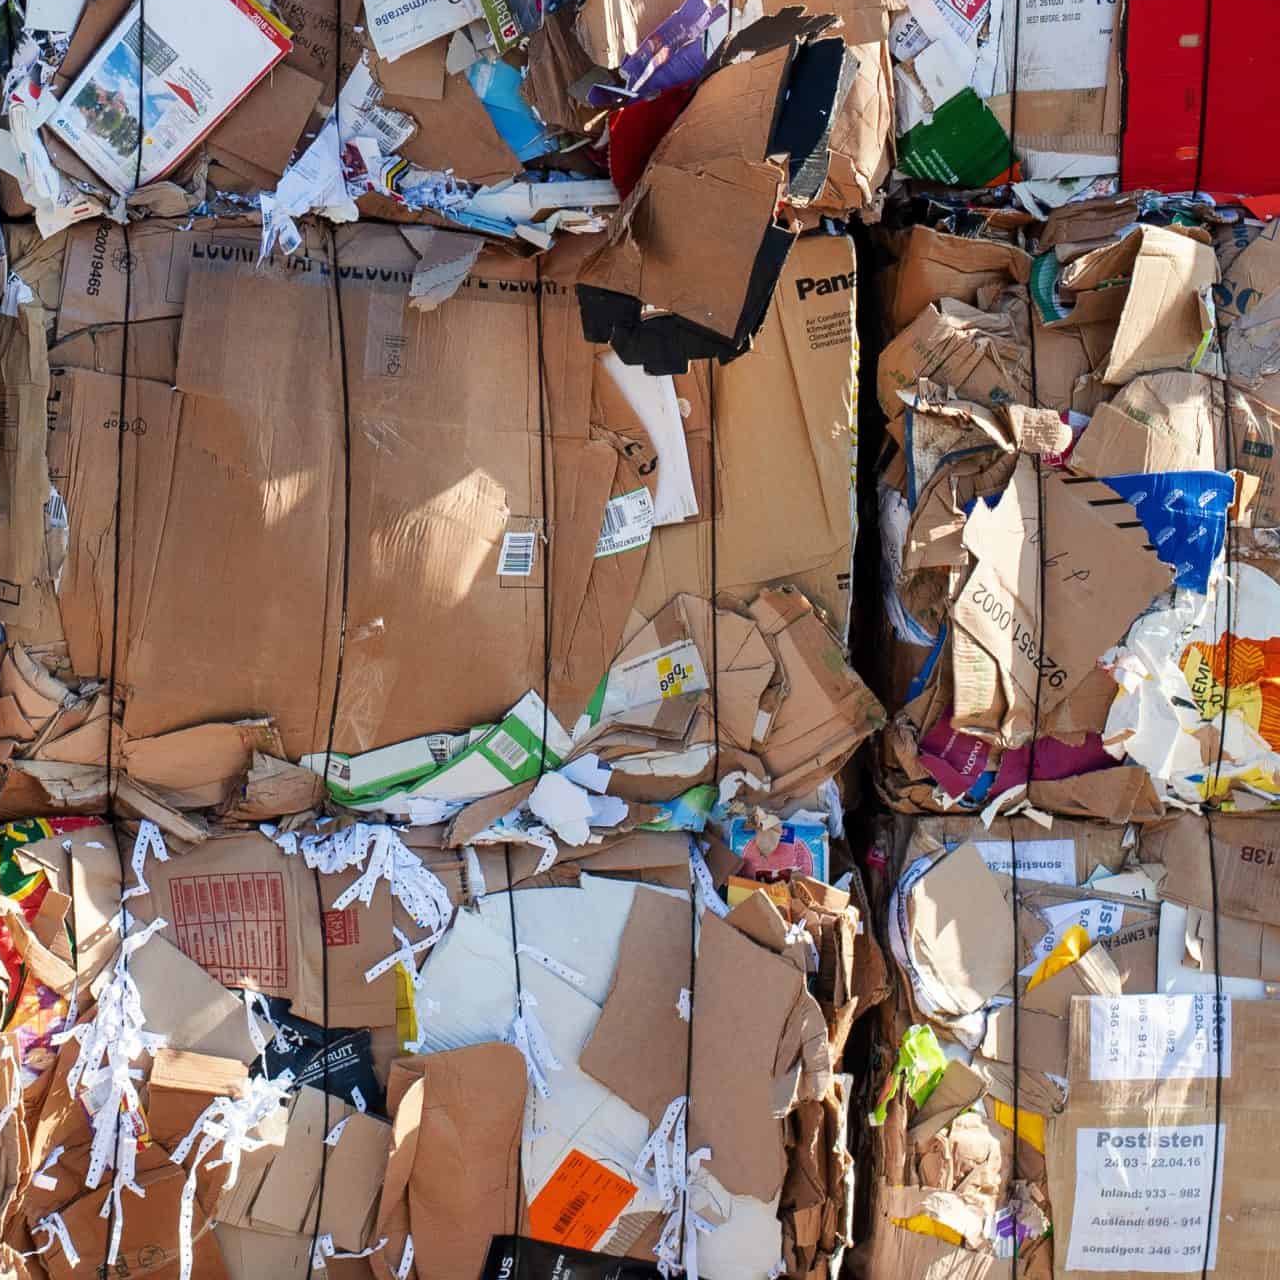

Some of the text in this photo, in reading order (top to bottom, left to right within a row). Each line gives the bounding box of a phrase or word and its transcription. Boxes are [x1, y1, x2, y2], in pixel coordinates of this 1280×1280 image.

[249, 12, 269, 31] 2016
[660, 663, 688, 692] TDBG
[1240, 845, 1276, 865] 13B
[1096, 1131, 1204, 1148] Postlsten
[1100, 1188, 1142, 1199] Inland:
[1091, 1216, 1144, 1227] Ausland:
[1082, 1244, 1144, 1257] sonstiges:
